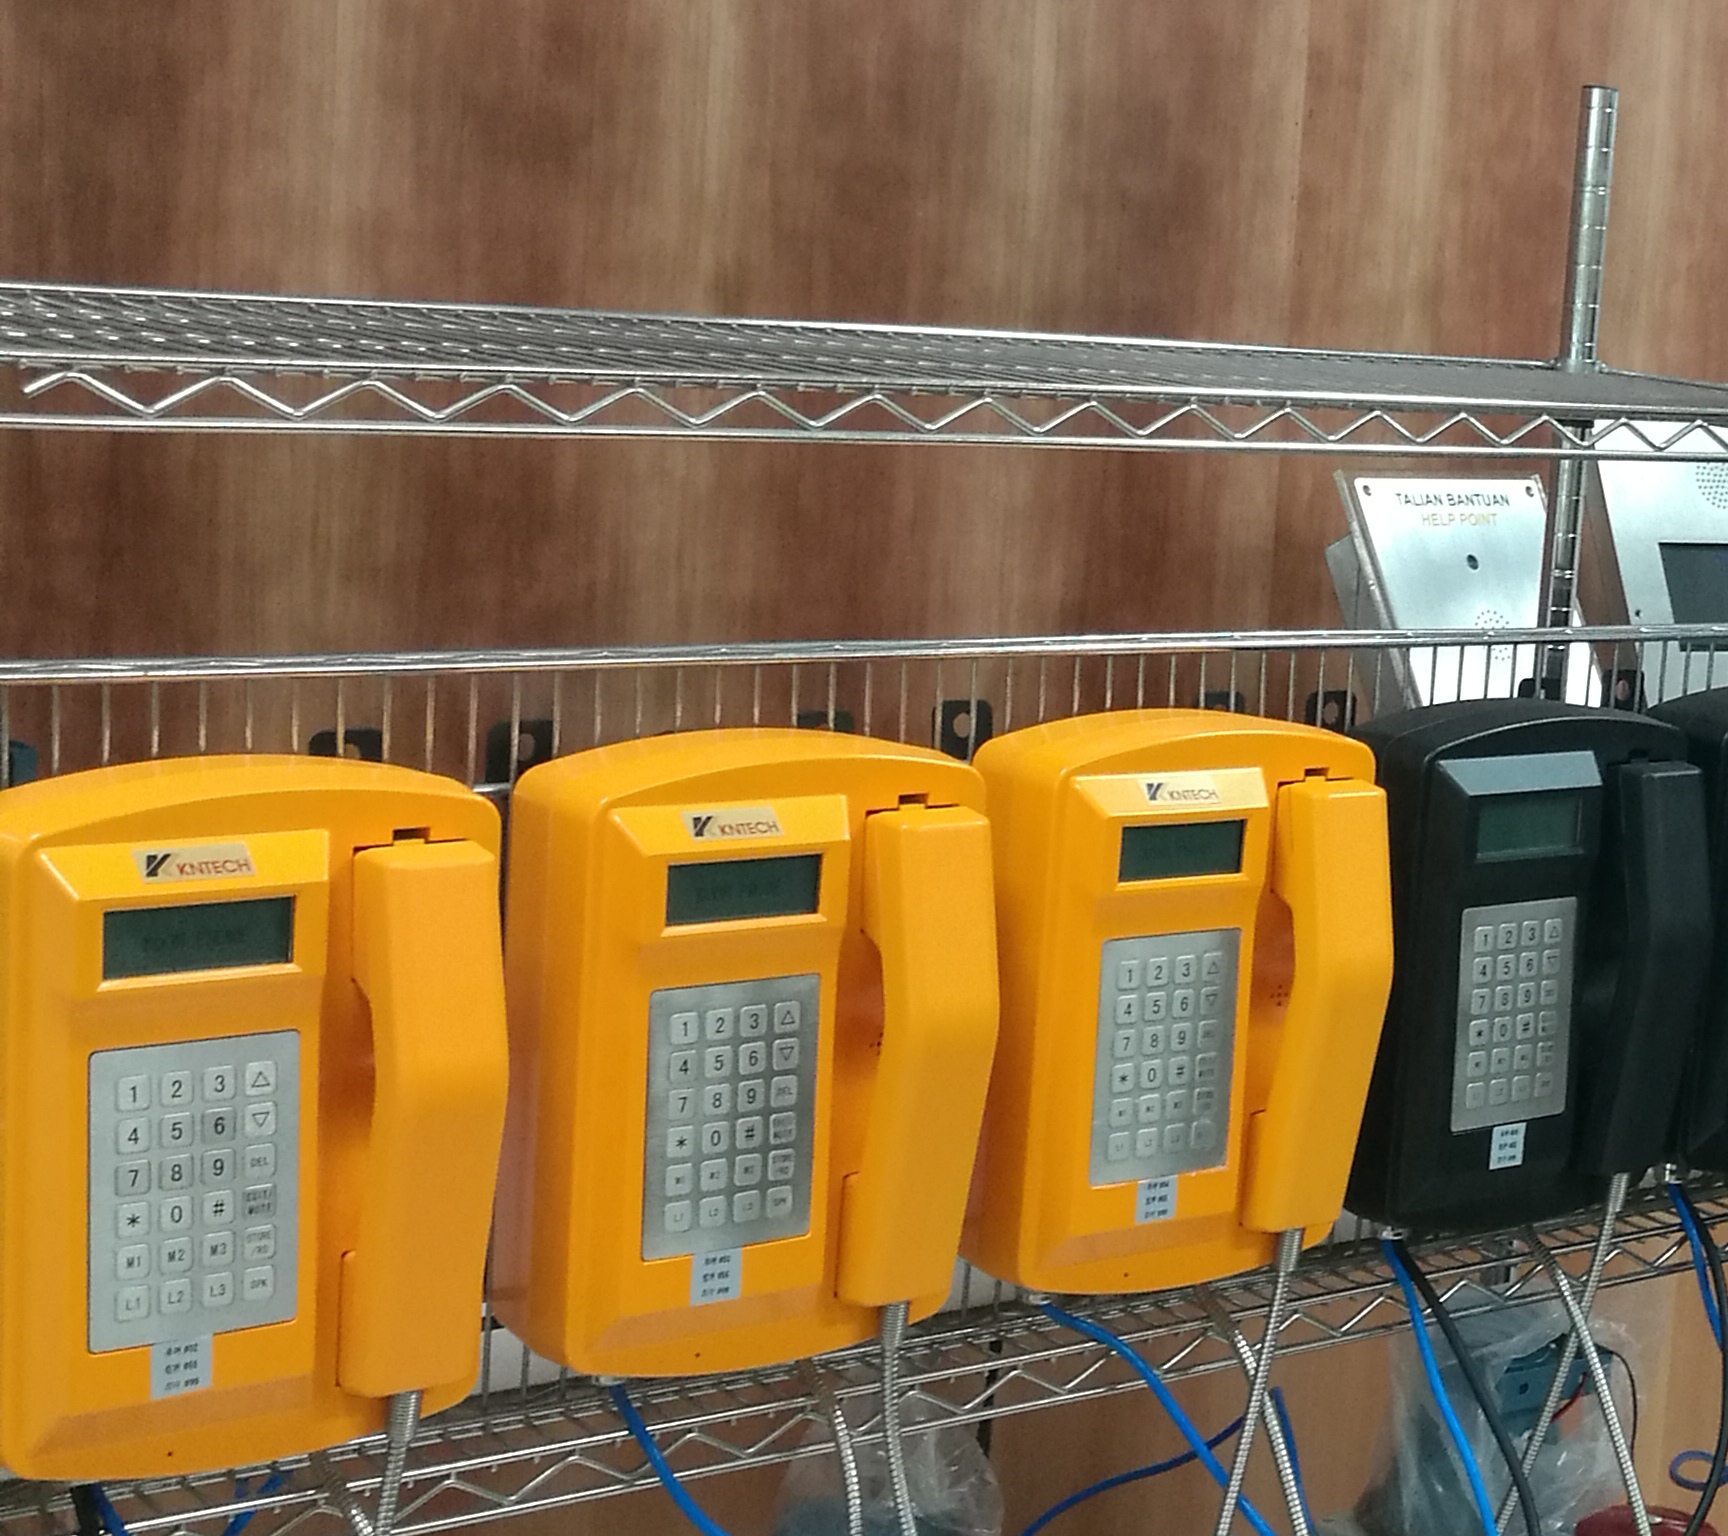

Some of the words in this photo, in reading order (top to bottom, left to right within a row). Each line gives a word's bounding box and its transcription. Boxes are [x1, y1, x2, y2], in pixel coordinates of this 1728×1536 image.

[1395, 493, 1443, 506] TALIAN
[1447, 493, 1510, 507] BANTUAN
[1422, 513, 1456, 527] HELP
[1459, 513, 1498, 527] POINT
[718, 821, 780, 836] KNTECH
[176, 859, 250, 876] KNTECH
[715, 1017, 726, 1034] 2
[749, 1013, 760, 1030] 3
[678, 1058, 690, 1075] 4
[713, 1054, 724, 1071] 5
[748, 1050, 759, 1067] 6
[171, 1079, 183, 1099] 2
[213, 1074, 226, 1093] 3
[677, 1096, 688, 1113] 7
[712, 1092, 723, 1109] 8
[746, 1087, 757, 1104] 9
[127, 1126, 140, 1145] 4
[171, 1121, 183, 1140] 5
[213, 1116, 226, 1135] 6
[710, 1129, 721, 1147] 0
[128, 1169, 139, 1187] 7
[170, 1164, 183, 1182] 8
[212, 1158, 225, 1177] 9
[169, 1205, 183, 1223] 0
[212, 1199, 226, 1217] #
[167, 1248, 186, 1263] M2
[209, 1242, 227, 1257] M3
[125, 1297, 141, 1311] L1
[167, 1290, 184, 1305] L2
[209, 1283, 226, 1298] L3
